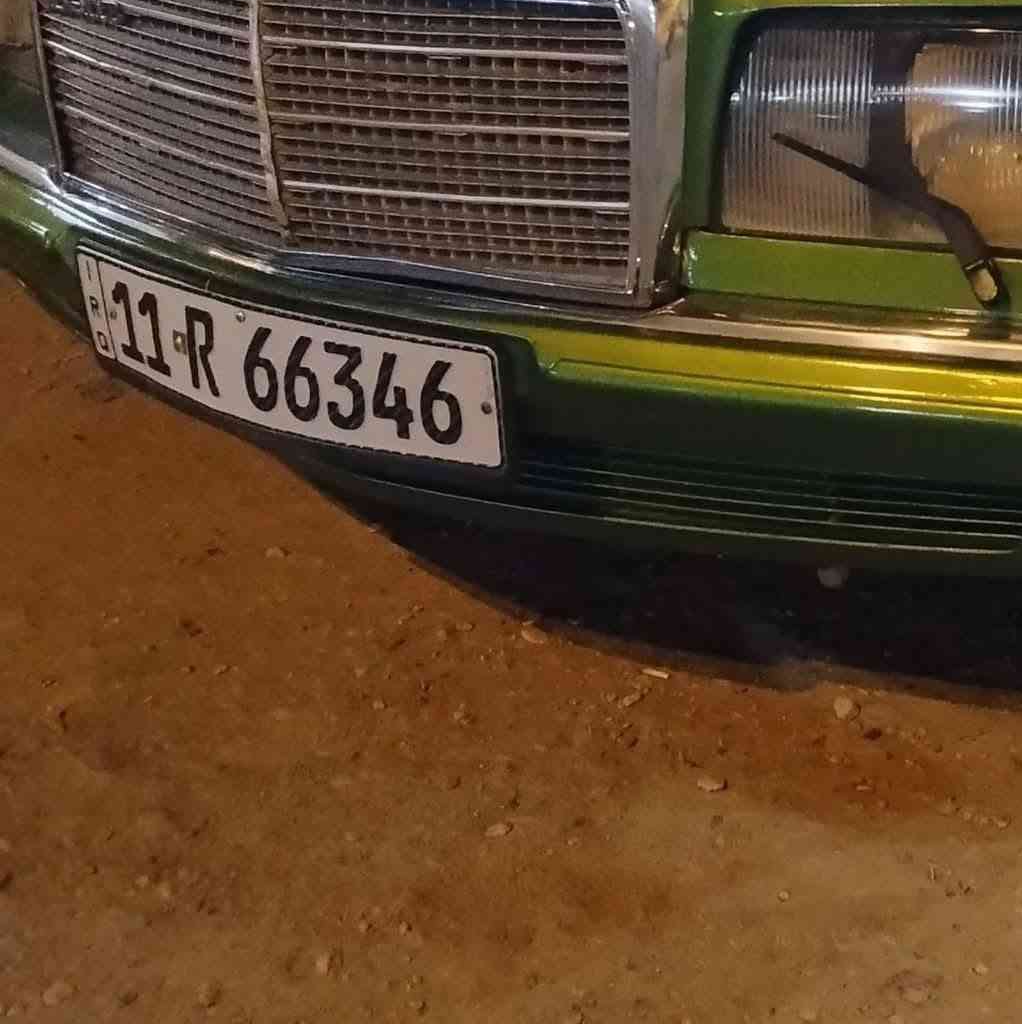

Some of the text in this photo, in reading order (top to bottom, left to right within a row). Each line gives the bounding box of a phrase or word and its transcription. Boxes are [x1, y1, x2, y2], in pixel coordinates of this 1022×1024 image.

[111, 281, 463, 445] 11 R 66346
